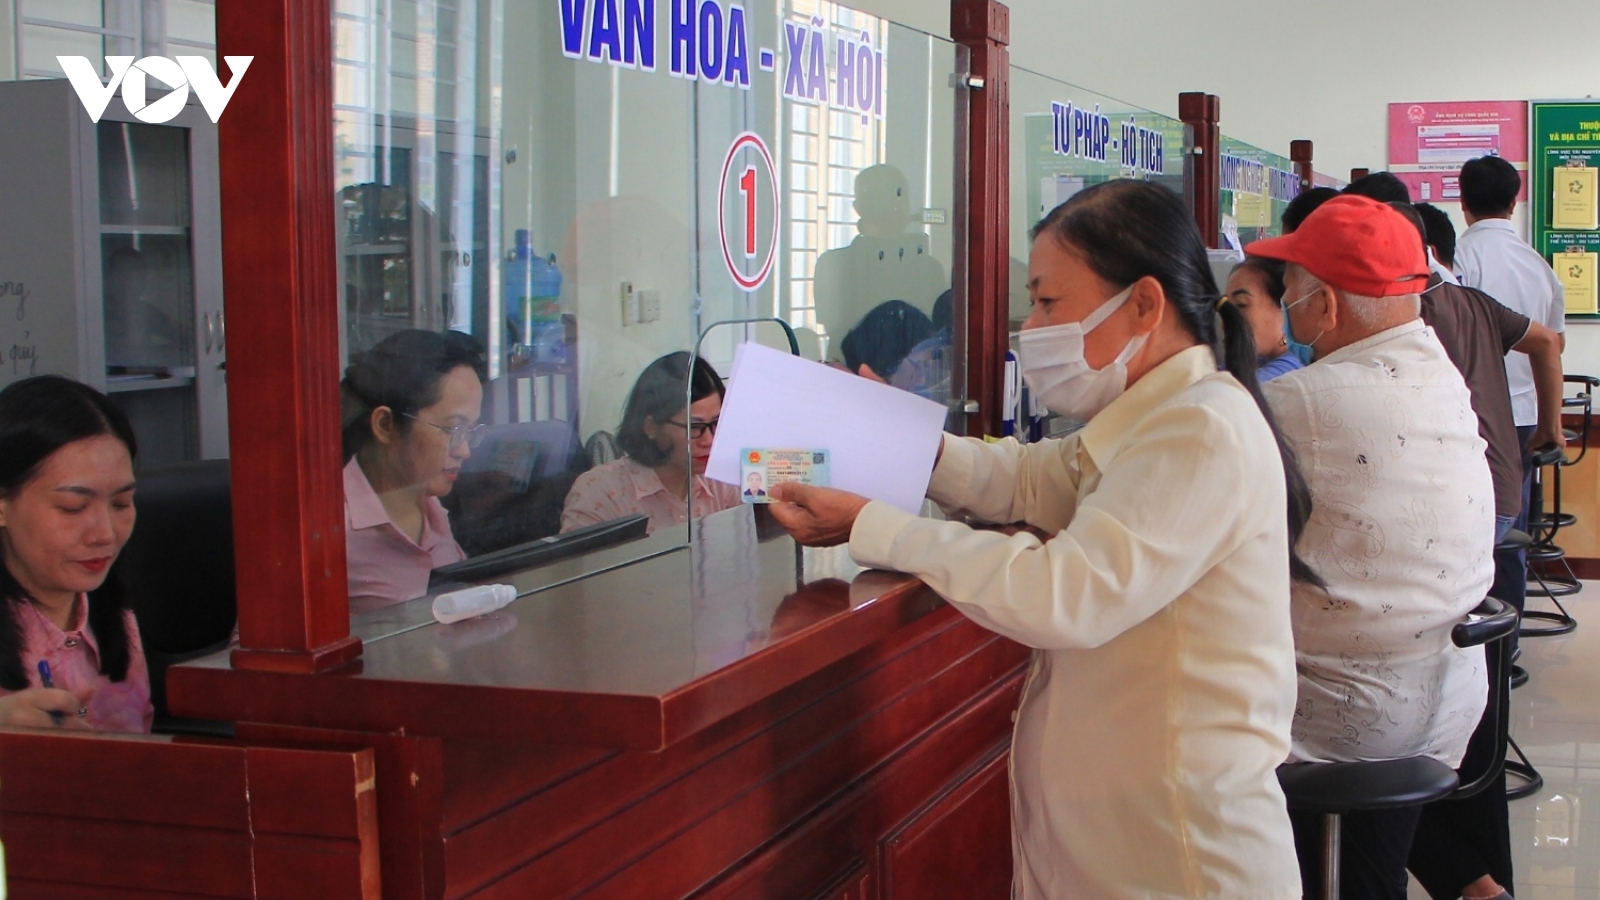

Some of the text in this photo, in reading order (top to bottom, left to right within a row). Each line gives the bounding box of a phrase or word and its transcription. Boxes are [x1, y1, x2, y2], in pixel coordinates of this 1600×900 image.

[783, 16, 828, 105] XÃ
[836, 28, 883, 126] HỘI
[1051, 100, 1072, 156] TƯ
[1073, 103, 1110, 163] PHÁP
[1121, 114, 1138, 179] HỘ
[1139, 127, 1163, 181] TỊCH
[1549, 131, 1560, 141] VÀ
[1561, 133, 1575, 143] ĐỊA
[739, 164, 757, 259] 1
